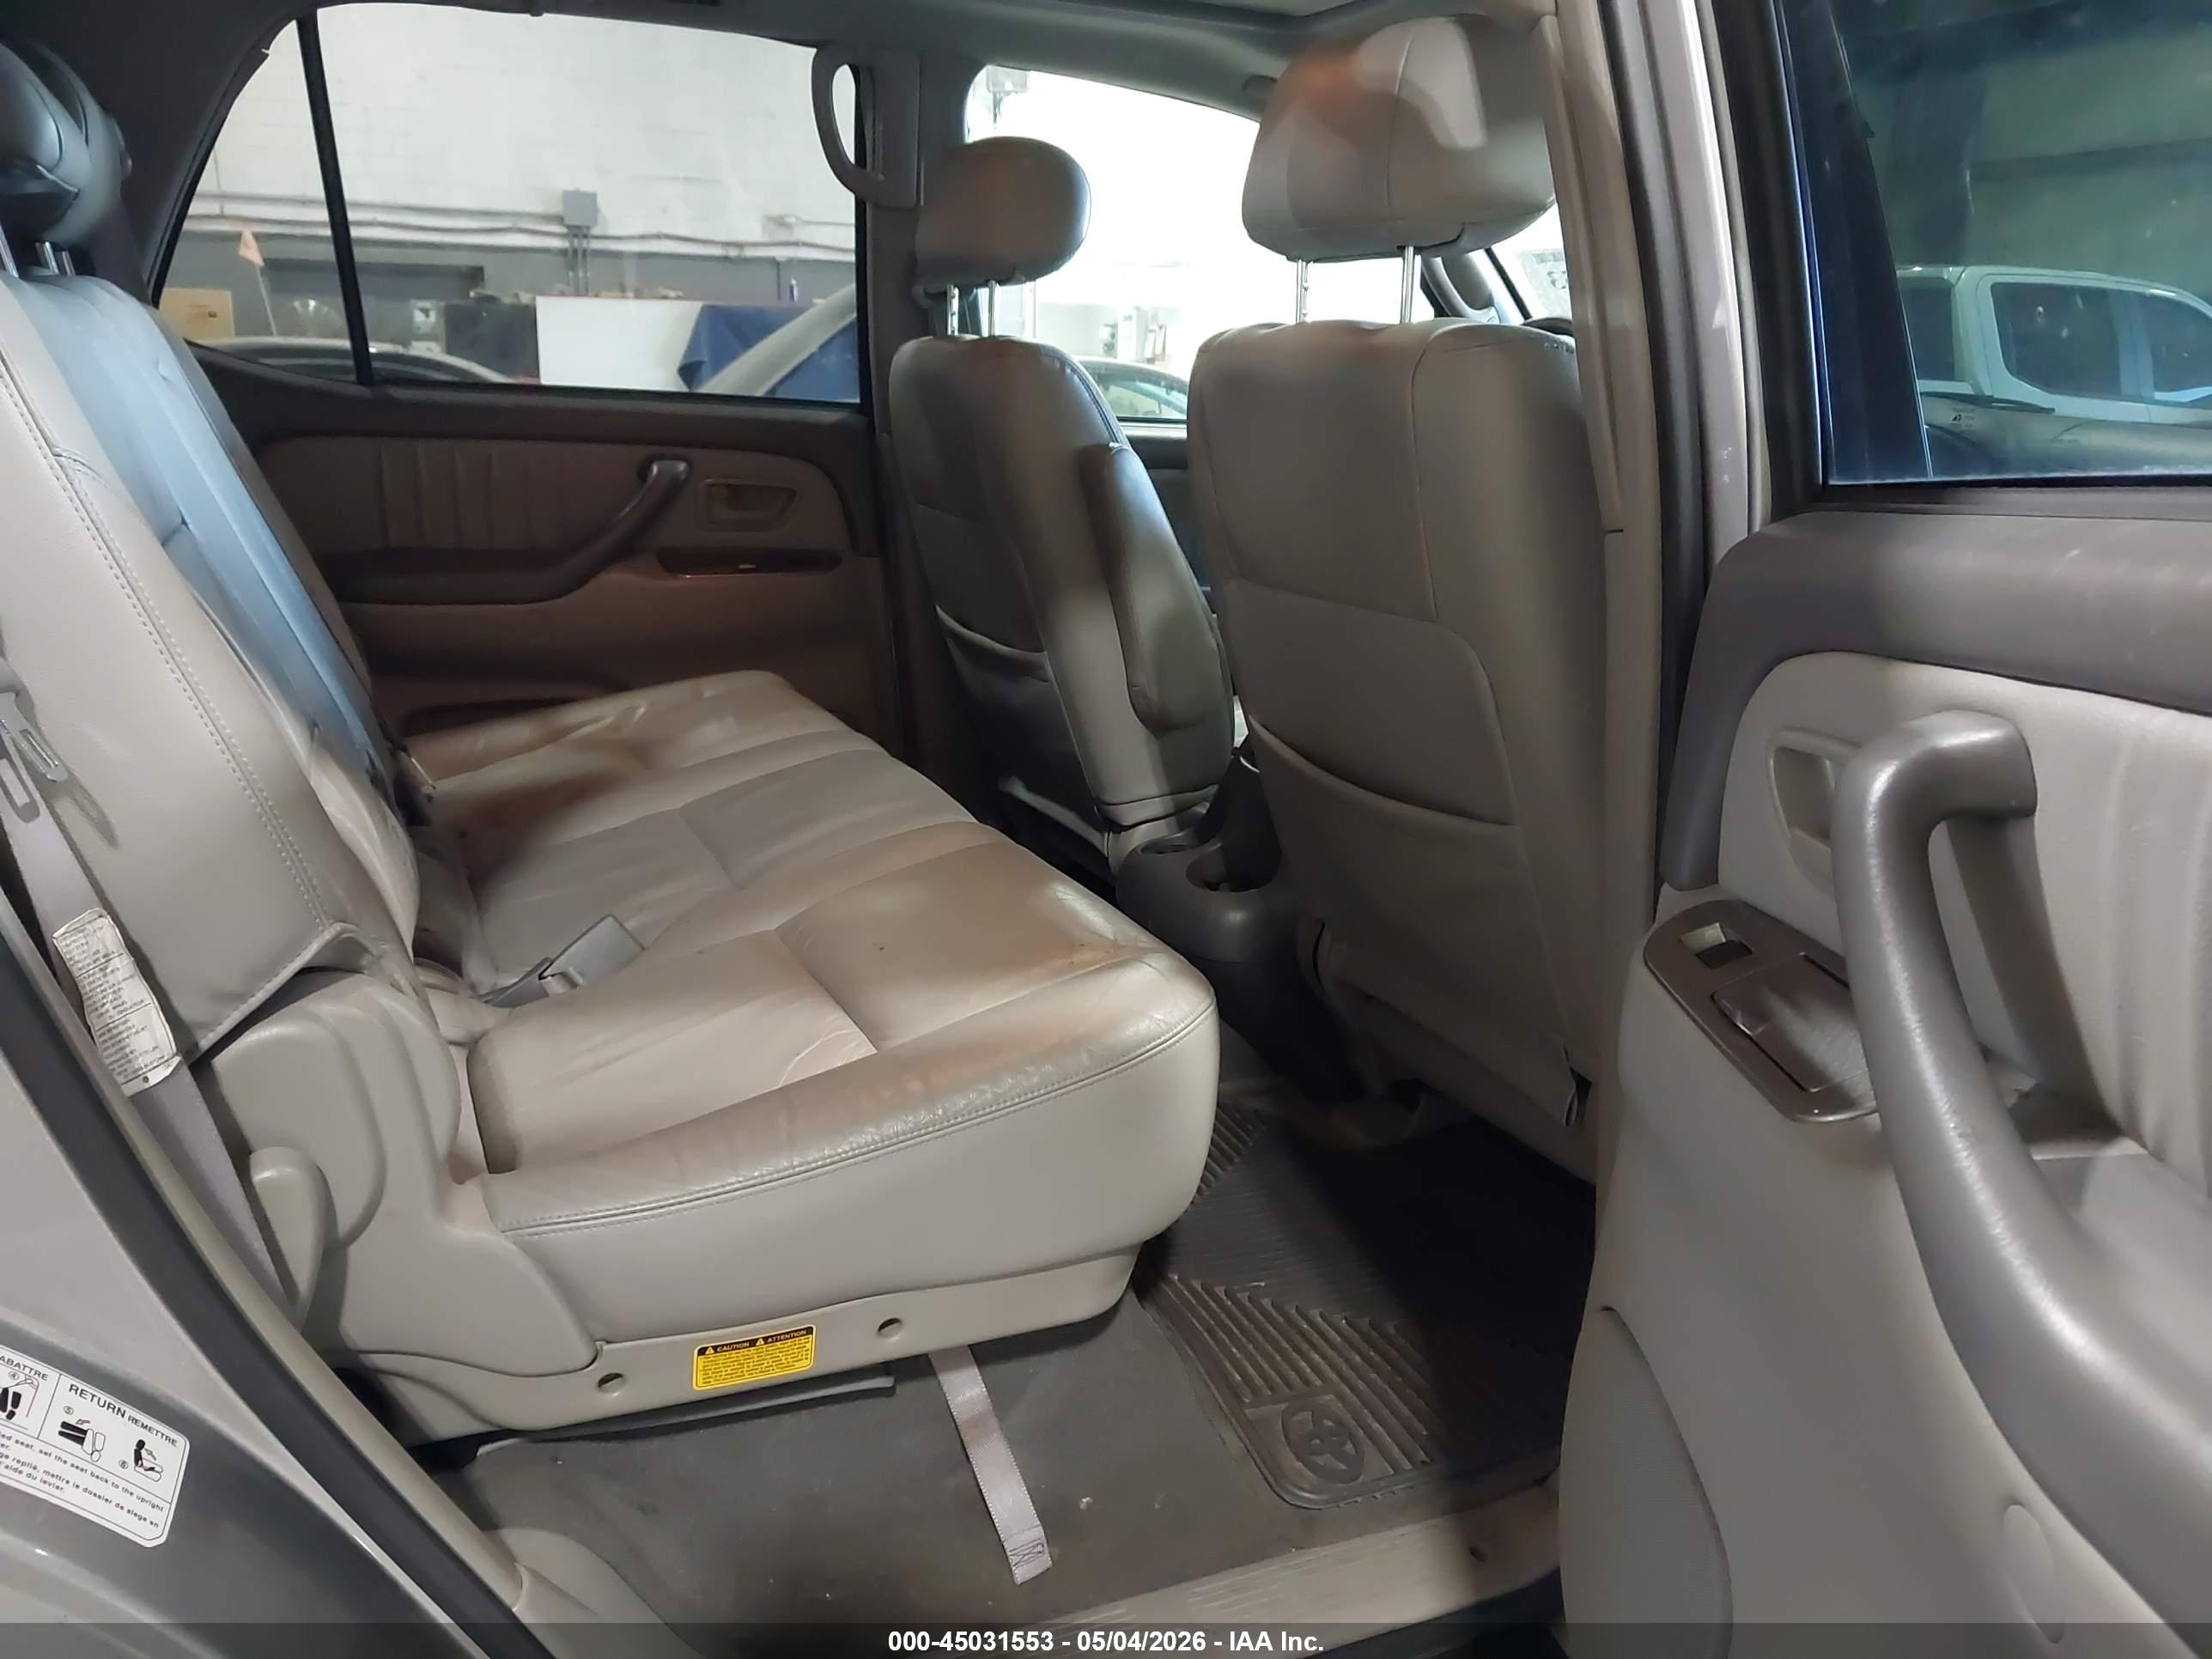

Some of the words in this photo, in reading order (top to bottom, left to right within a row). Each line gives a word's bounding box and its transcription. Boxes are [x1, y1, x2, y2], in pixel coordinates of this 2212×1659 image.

[717, 1341, 750, 1352] CAUTION
[767, 1330, 807, 1343] ATTENTION
[0, 1356, 48, 1381] ABATTRE
[69, 1383, 126, 1419] RETURN
[127, 1414, 179, 1448] REMETTRE
[0, 1431, 12, 1441] ed
[39, 1449, 52, 1458] set
[55, 1455, 68, 1465] the
[70, 1463, 88, 1474] seat
[89, 1471, 108, 1484] back
[122, 1486, 134, 1496] the
[136, 1494, 163, 1512] upright
[26, 1472, 38, 1480] du
[43, 1469, 70, 1486] mettre
[82, 1487, 112, 1504] dossier
[115, 1502, 124, 1511] de
[149, 1520, 159, 1528] en
